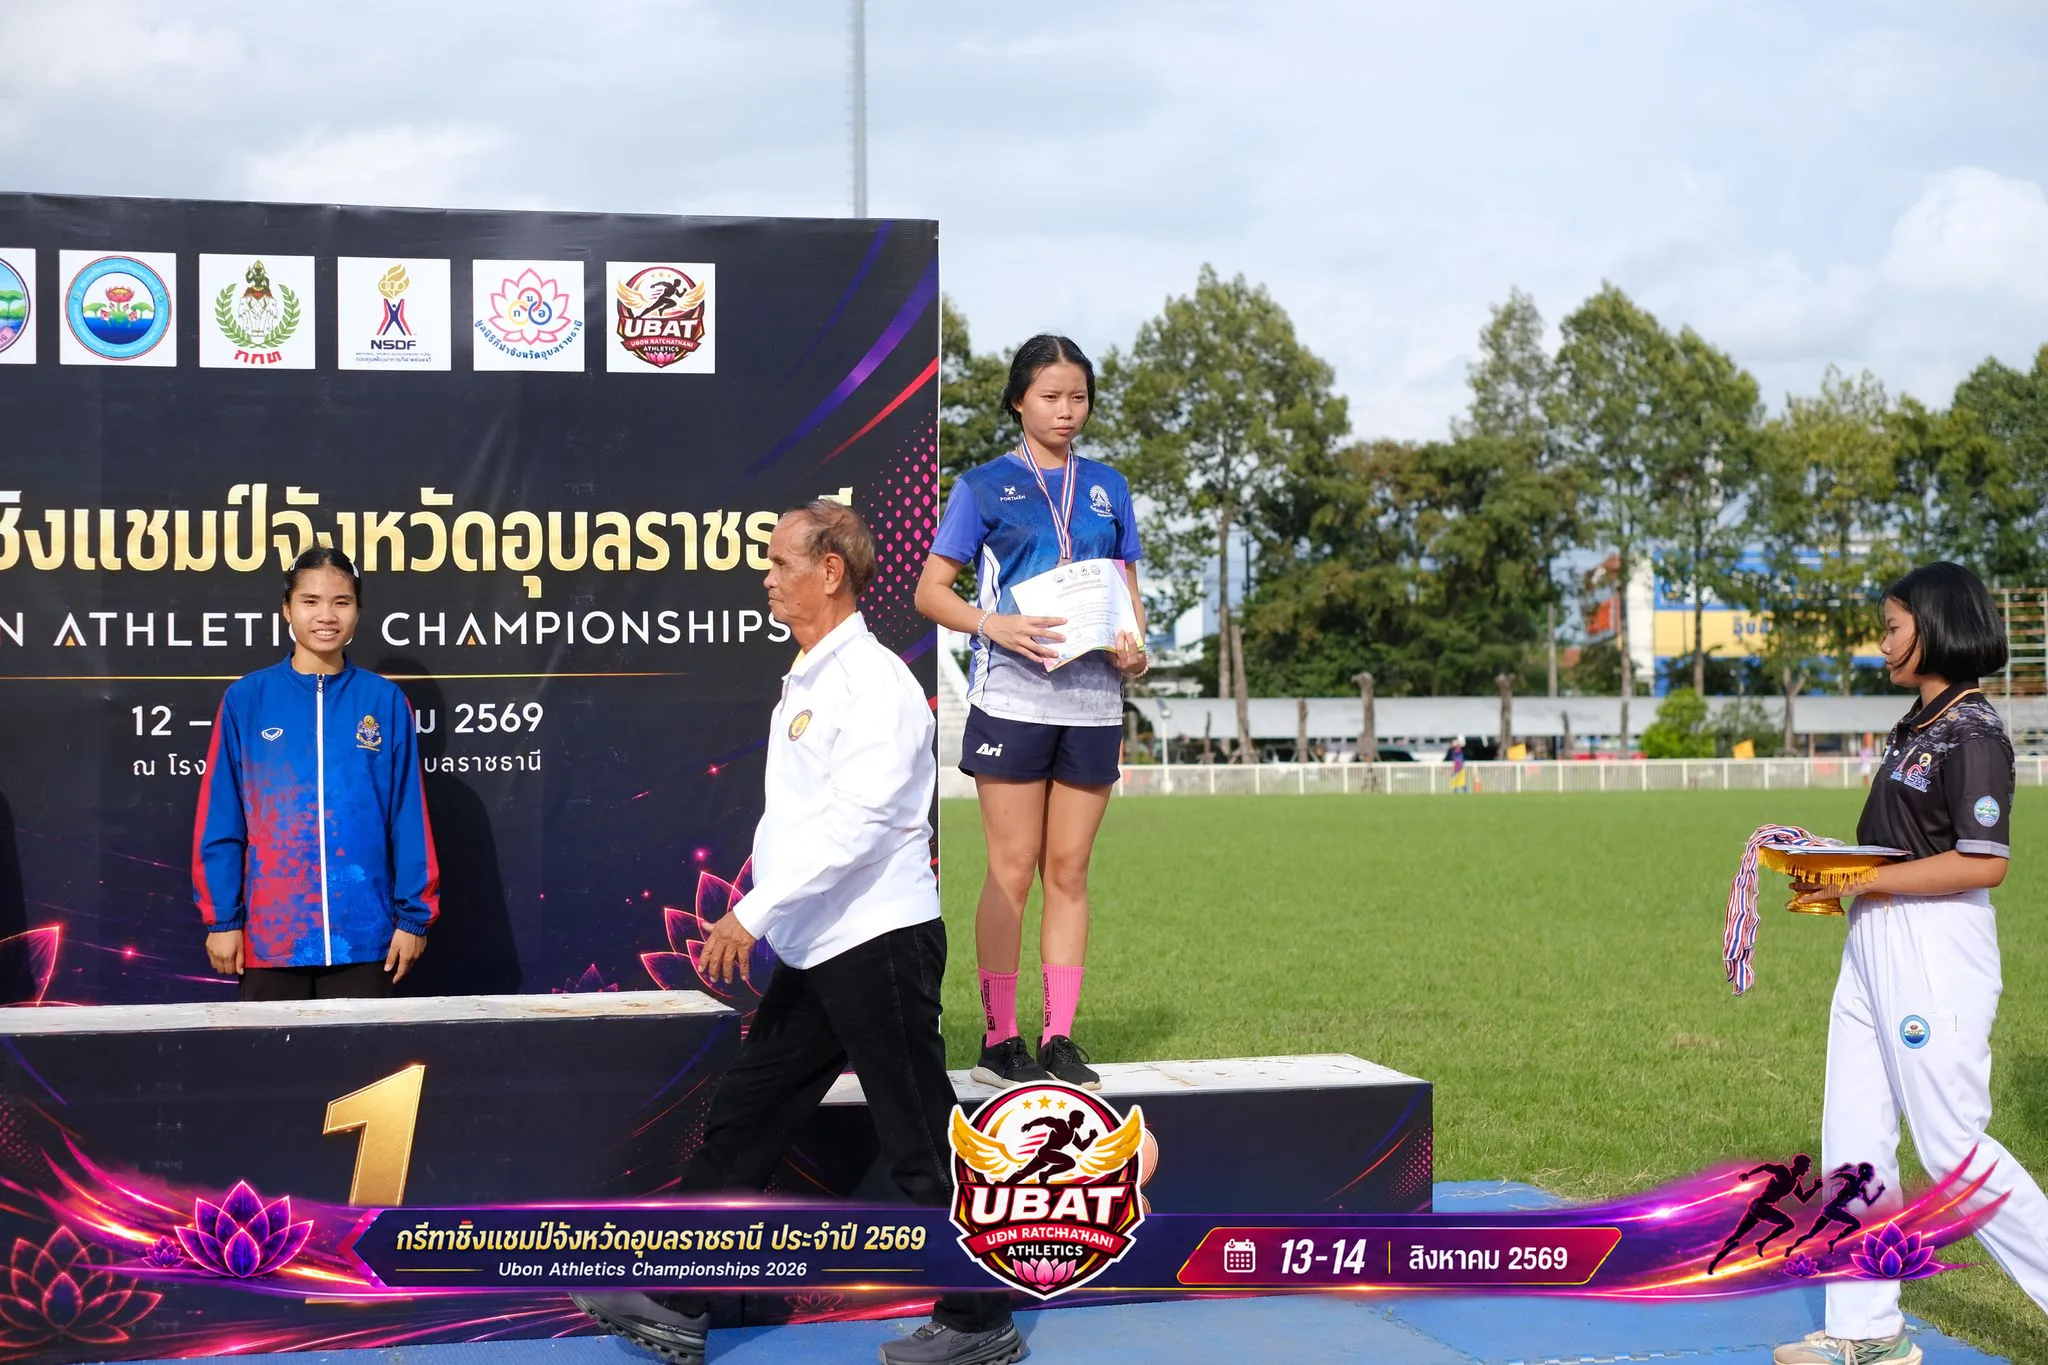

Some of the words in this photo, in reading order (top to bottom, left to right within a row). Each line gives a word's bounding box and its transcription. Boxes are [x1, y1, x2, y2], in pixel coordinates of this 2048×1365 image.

[623, 318, 698, 338] UBAT
[370, 339, 416, 350] NSDF
[381, 610, 791, 647] CHAMPIONSHIPS
[132, 705, 172, 736] 12
[454, 701, 544, 734] 2569
[133, 759, 155, 776] ณ
